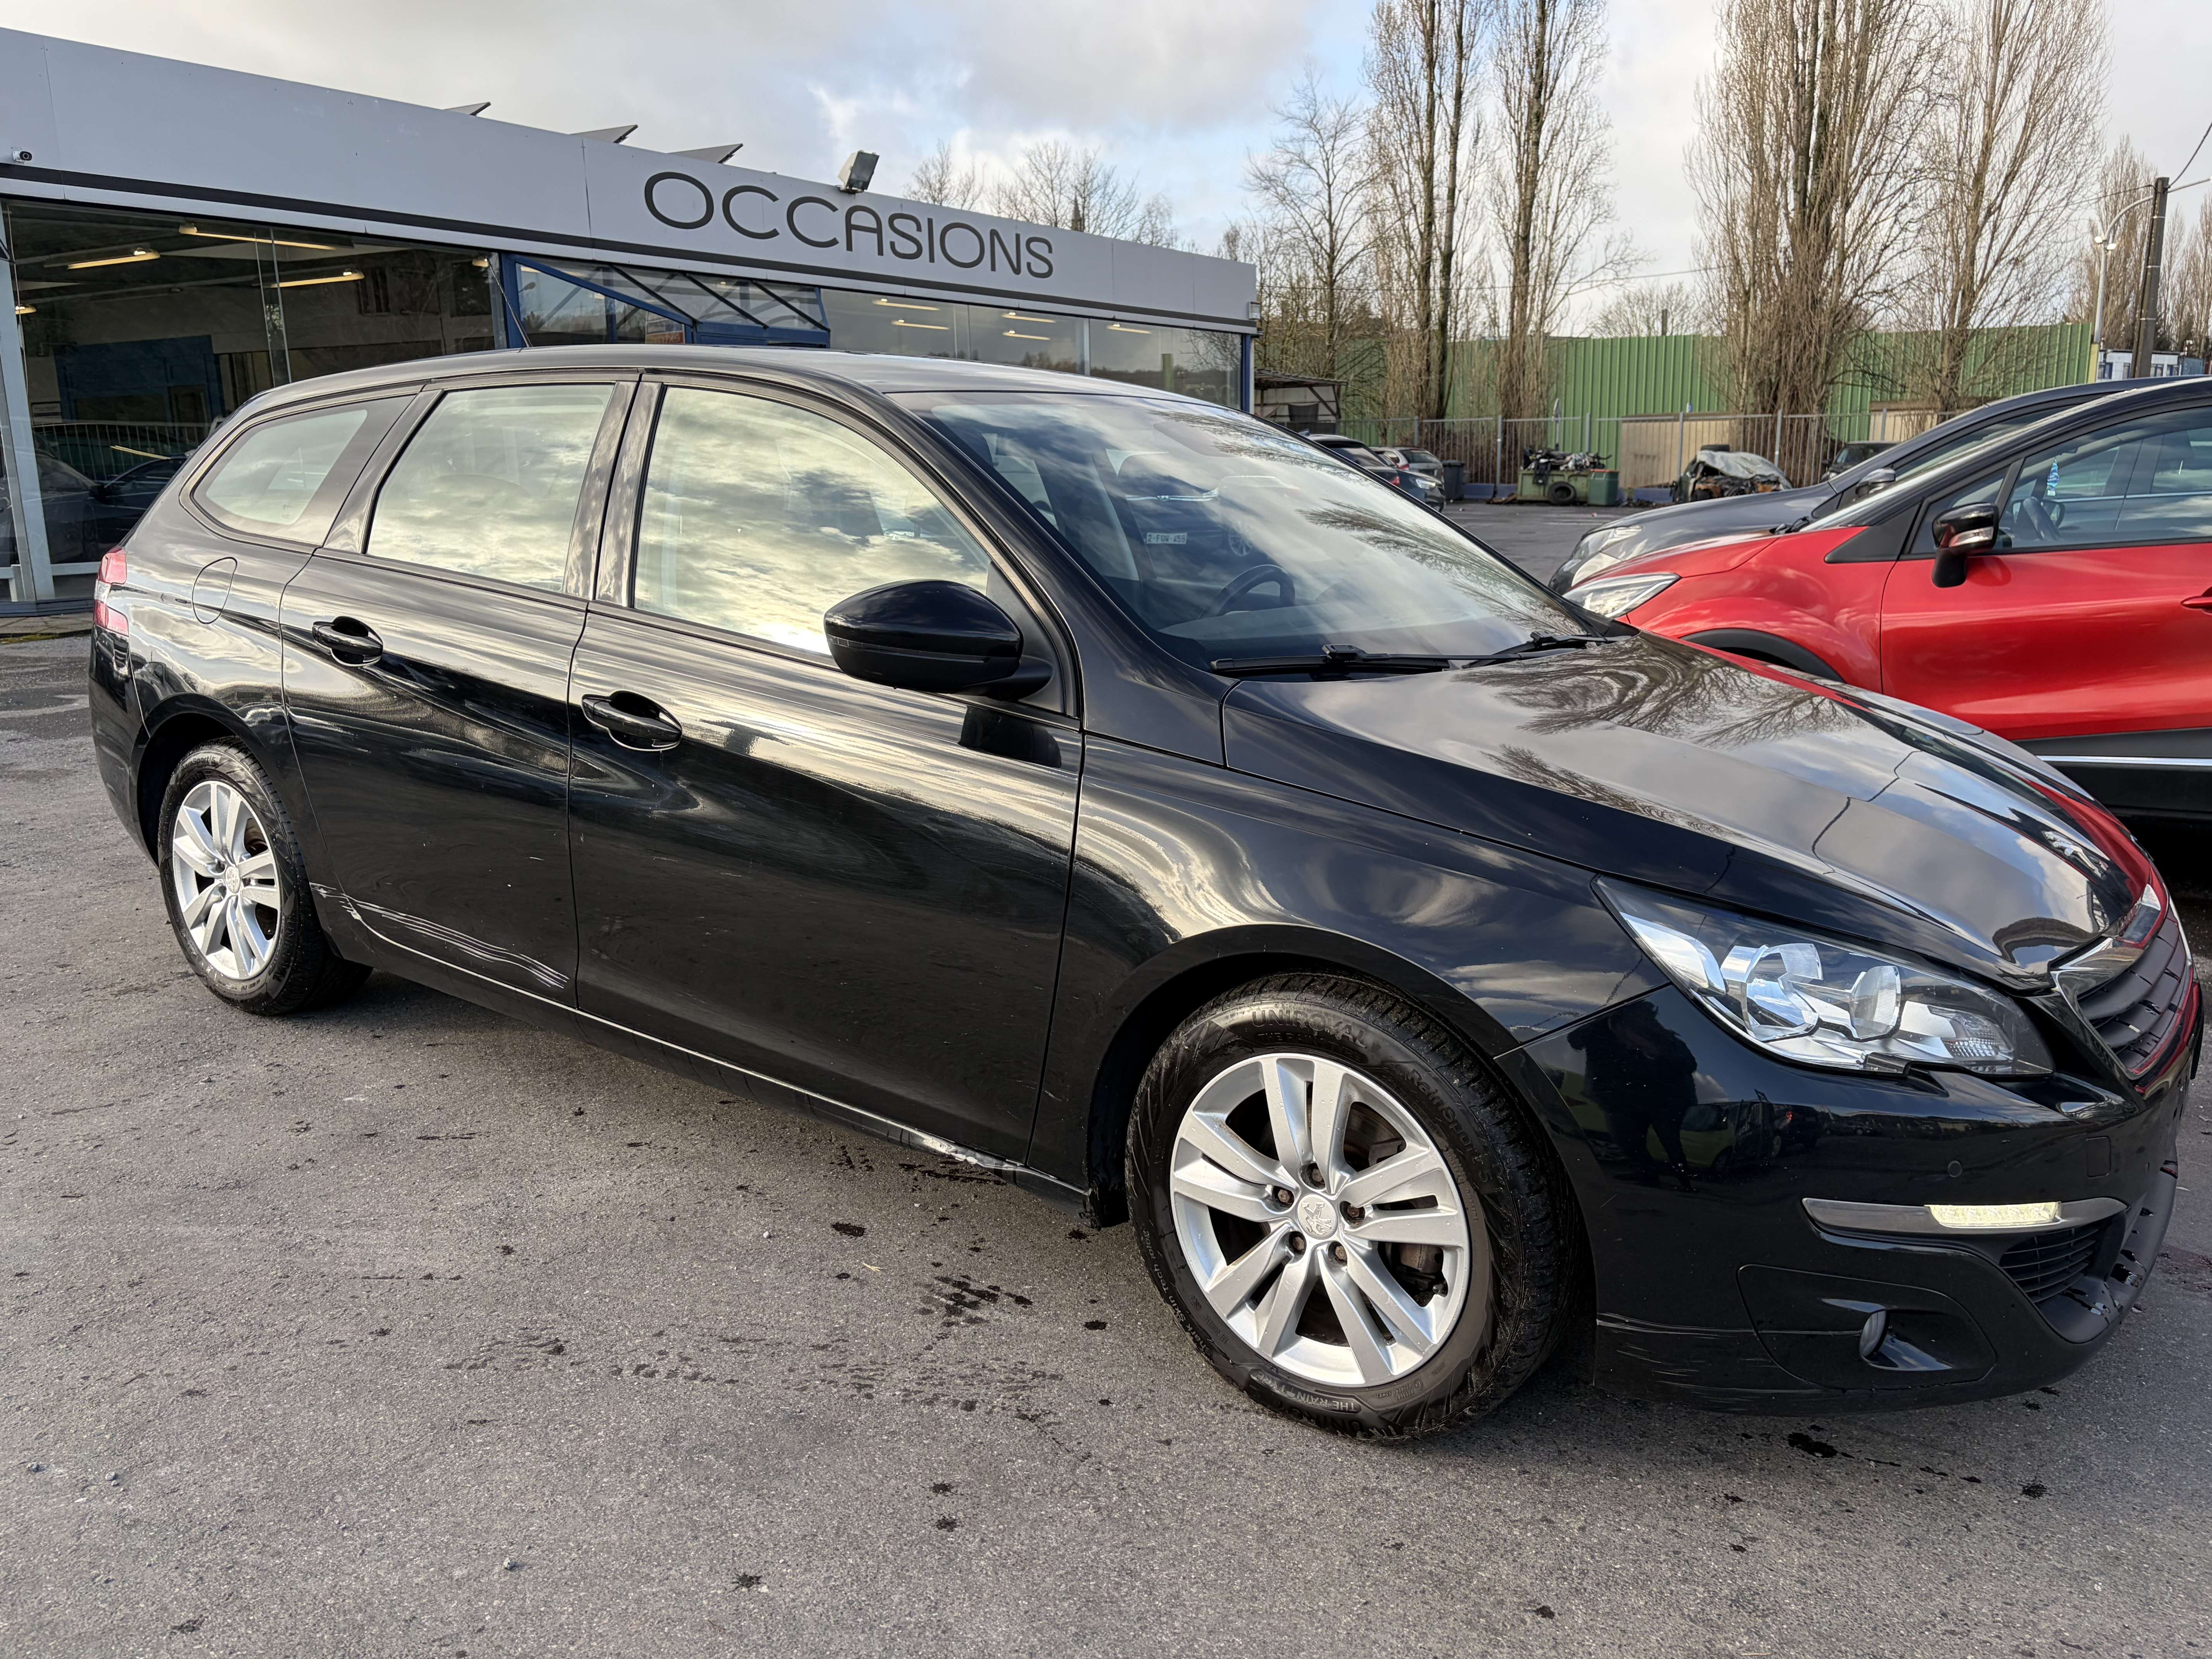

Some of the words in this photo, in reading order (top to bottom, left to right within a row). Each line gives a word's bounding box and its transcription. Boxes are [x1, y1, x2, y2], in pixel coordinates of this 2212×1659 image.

[644, 171, 1054, 279] OCCASIONS
[181, 756, 210, 773] RainSport
[1251, 1009, 1368, 1049] UNIROYAL
[1478, 1168, 1493, 1183] 5
[1168, 1295, 1186, 1322] Skin
[1186, 1323, 1212, 1356] Shark
[1256, 1372, 1290, 1397] TYRE
[1297, 1394, 1329, 1408] RAIN
[1332, 1400, 1357, 1412] THE
